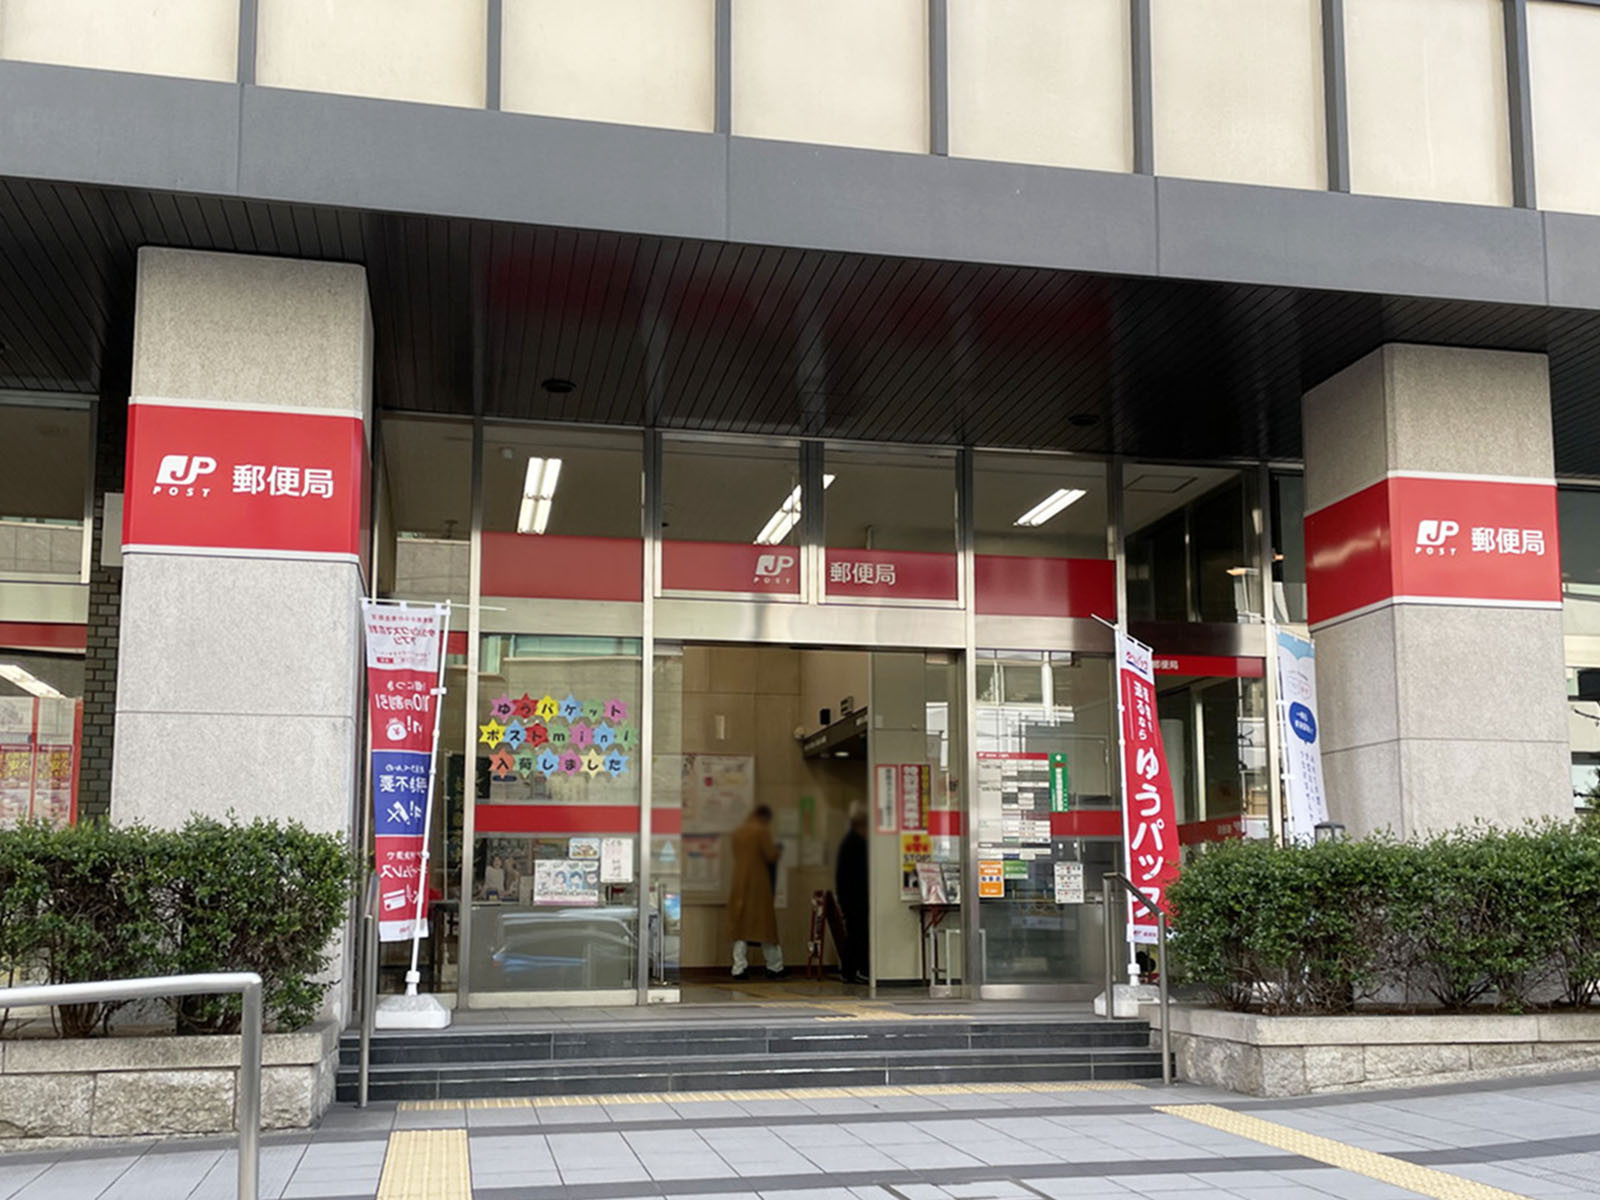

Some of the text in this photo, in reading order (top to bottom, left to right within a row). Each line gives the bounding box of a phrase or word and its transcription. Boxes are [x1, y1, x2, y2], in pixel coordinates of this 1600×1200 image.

[156, 455, 217, 485] JP
[232, 464, 334, 498] 郵便局
[153, 486, 211, 498] POST
[1416, 520, 1459, 546] JP
[1471, 527, 1545, 556] 郵便局
[1415, 546, 1457, 556] POST
[755, 554, 794, 576] JP
[830, 562, 896, 585] 郵便局
[753, 577, 791, 585] POST
[497, 703, 621, 717] ゆうパケット
[486, 729, 629, 743] ポストmini
[496, 758, 621, 771] 入荷しました
[1131, 746, 1165, 918] ゆうパック
